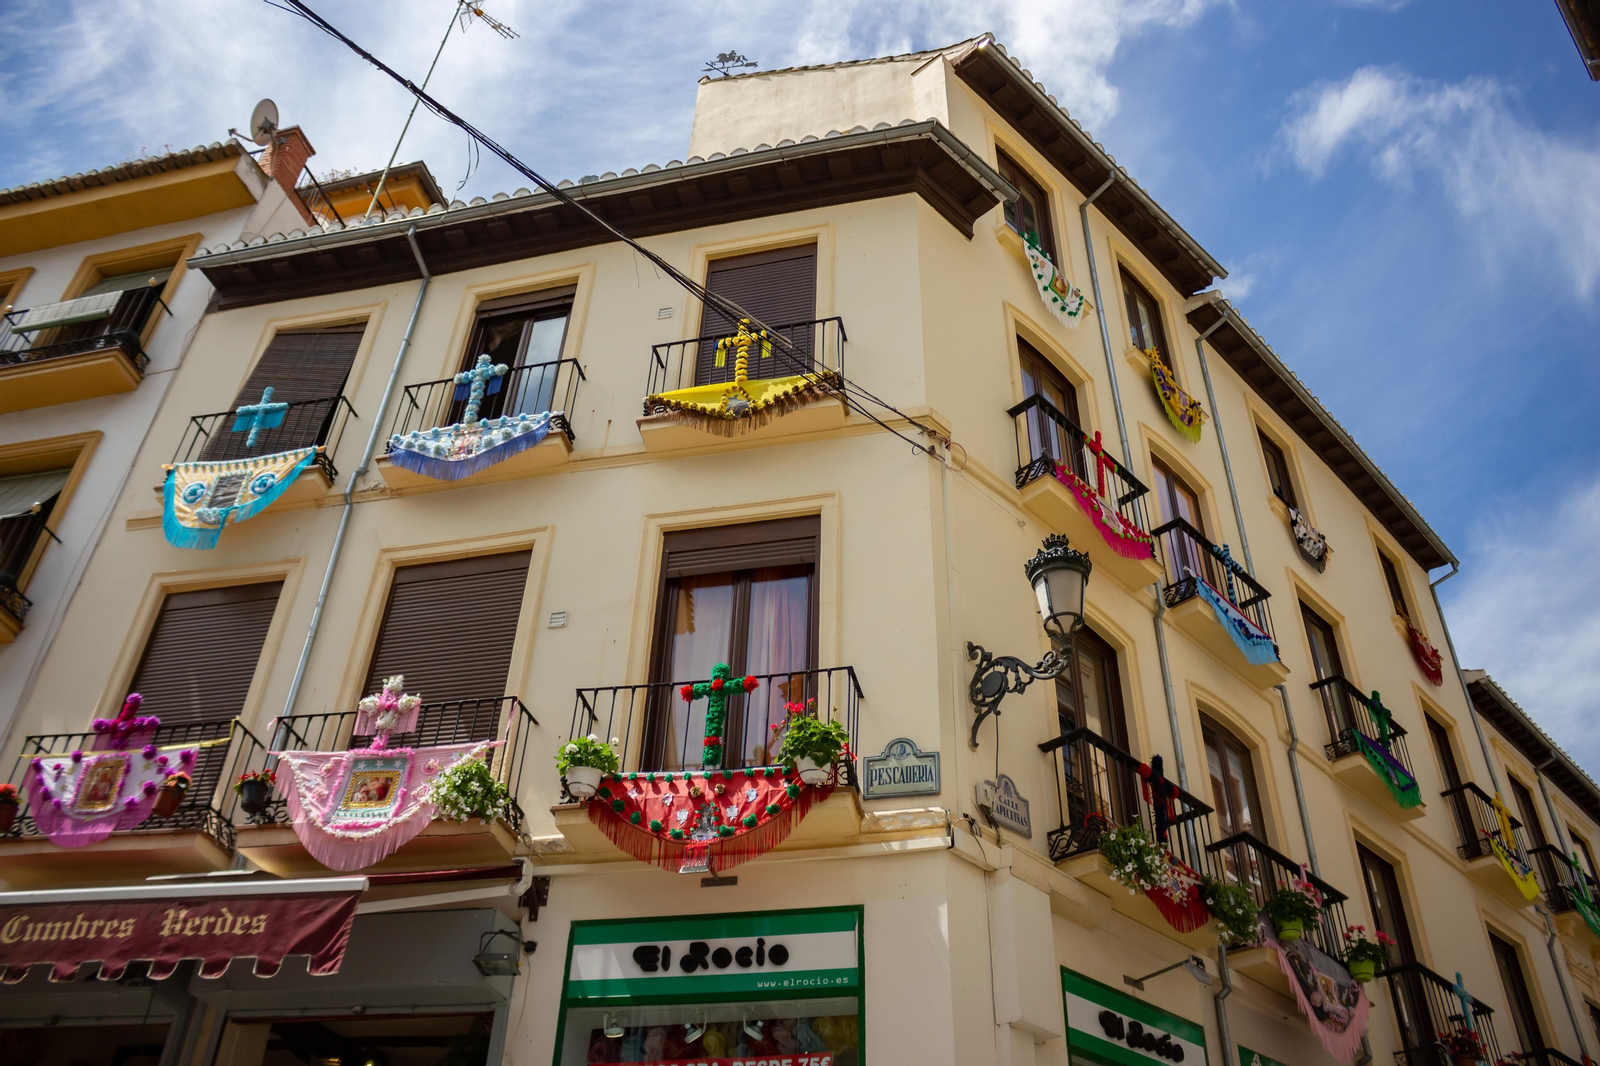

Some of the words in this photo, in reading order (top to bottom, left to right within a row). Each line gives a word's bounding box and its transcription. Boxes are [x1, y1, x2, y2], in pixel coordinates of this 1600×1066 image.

[869, 764, 934, 787] PESCADERIA
[998, 795, 1018, 812] CALLE
[1, 912, 137, 944] Cumbres
[158, 907, 269, 937] Verdes
[632, 945, 672, 972] El
[679, 938, 789, 973] Rocio
[757, 976, 849, 988] www.elrocio.es
[1099, 1010, 1125, 1040] El
[1125, 1021, 1184, 1063] Rocio
